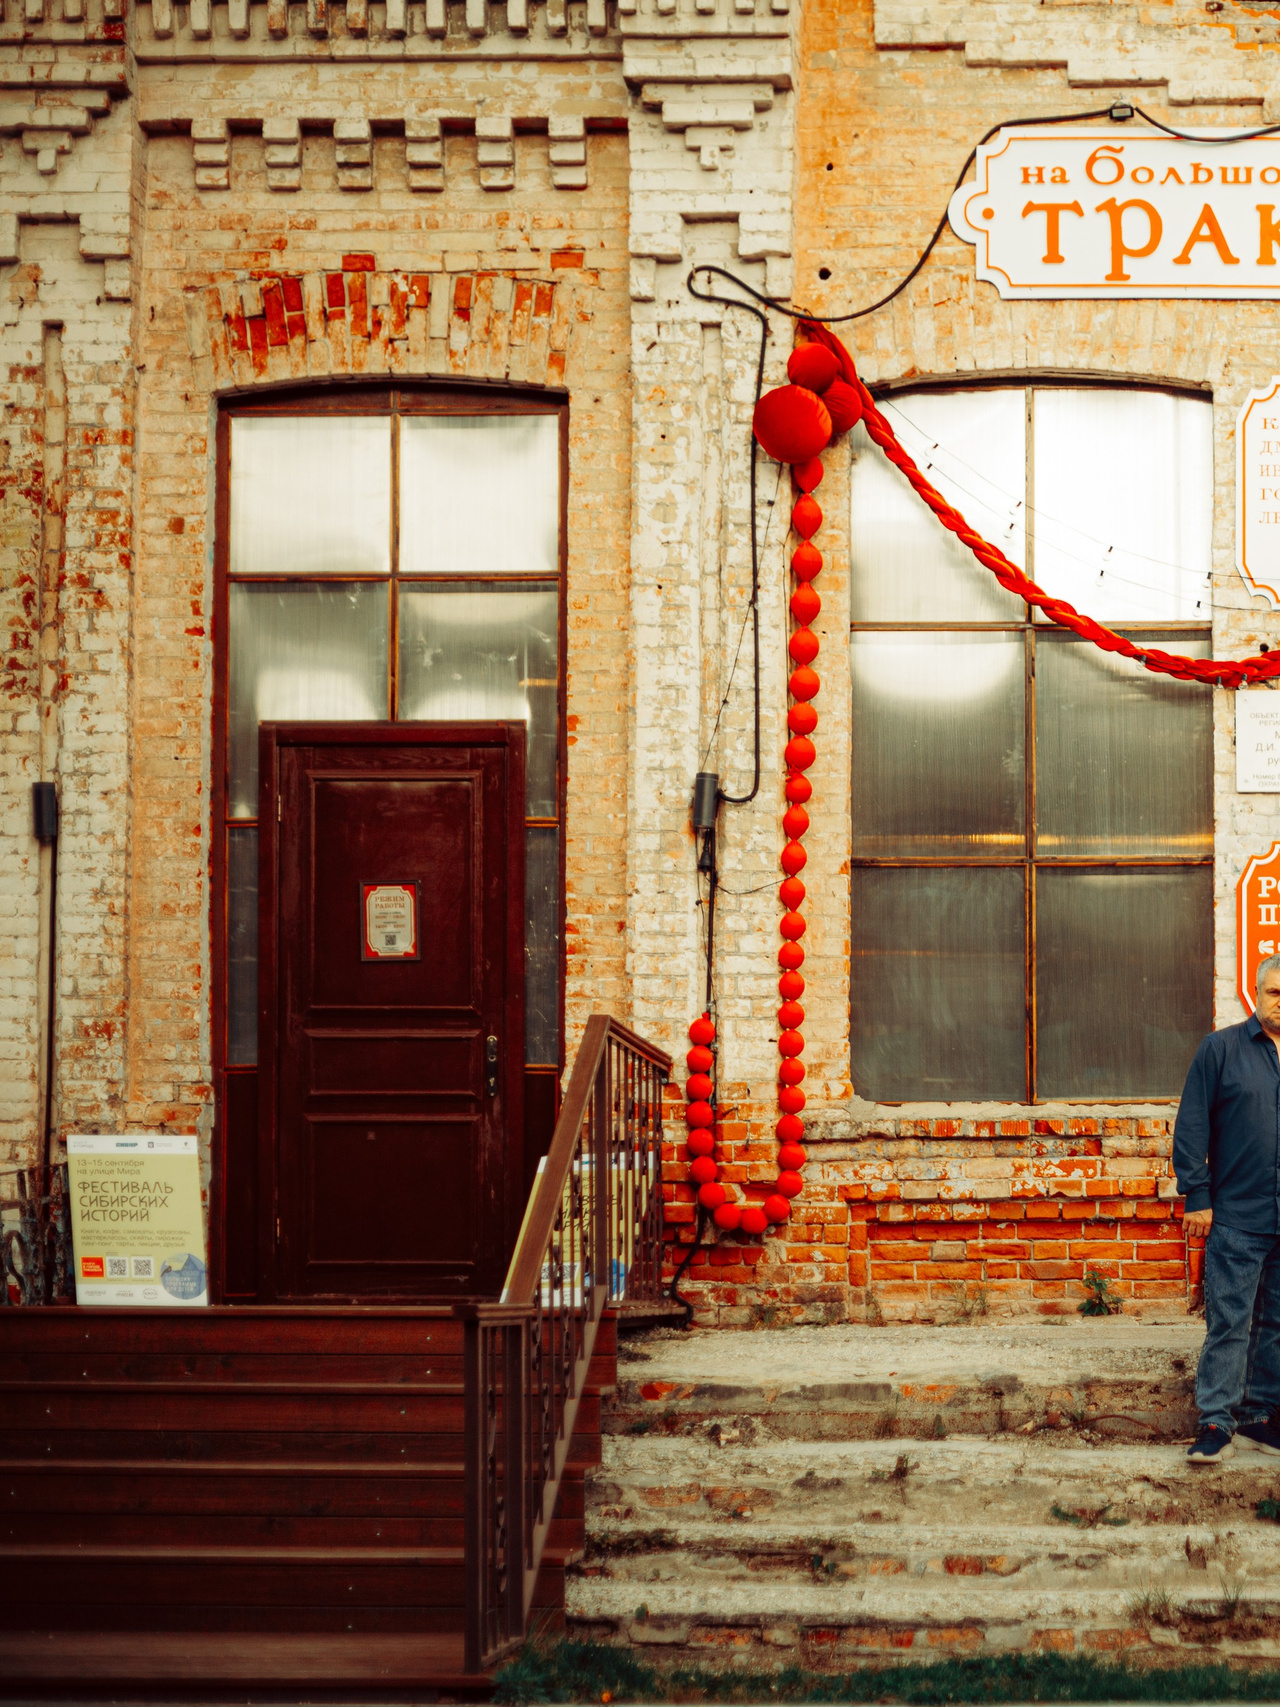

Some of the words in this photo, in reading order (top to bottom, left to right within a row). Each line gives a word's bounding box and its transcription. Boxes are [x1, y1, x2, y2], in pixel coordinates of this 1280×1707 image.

[1255, 743, 1277, 753] Д.И.
[104, 1159, 145, 1168] сентября
[117, 1168, 141, 1176] Мира
[78, 1181, 173, 1194] ФЕСТИВАЛЬ
[79, 1195, 169, 1208] СИБИРСКИХ
[81, 1208, 150, 1222] ИСТОРИЙ
